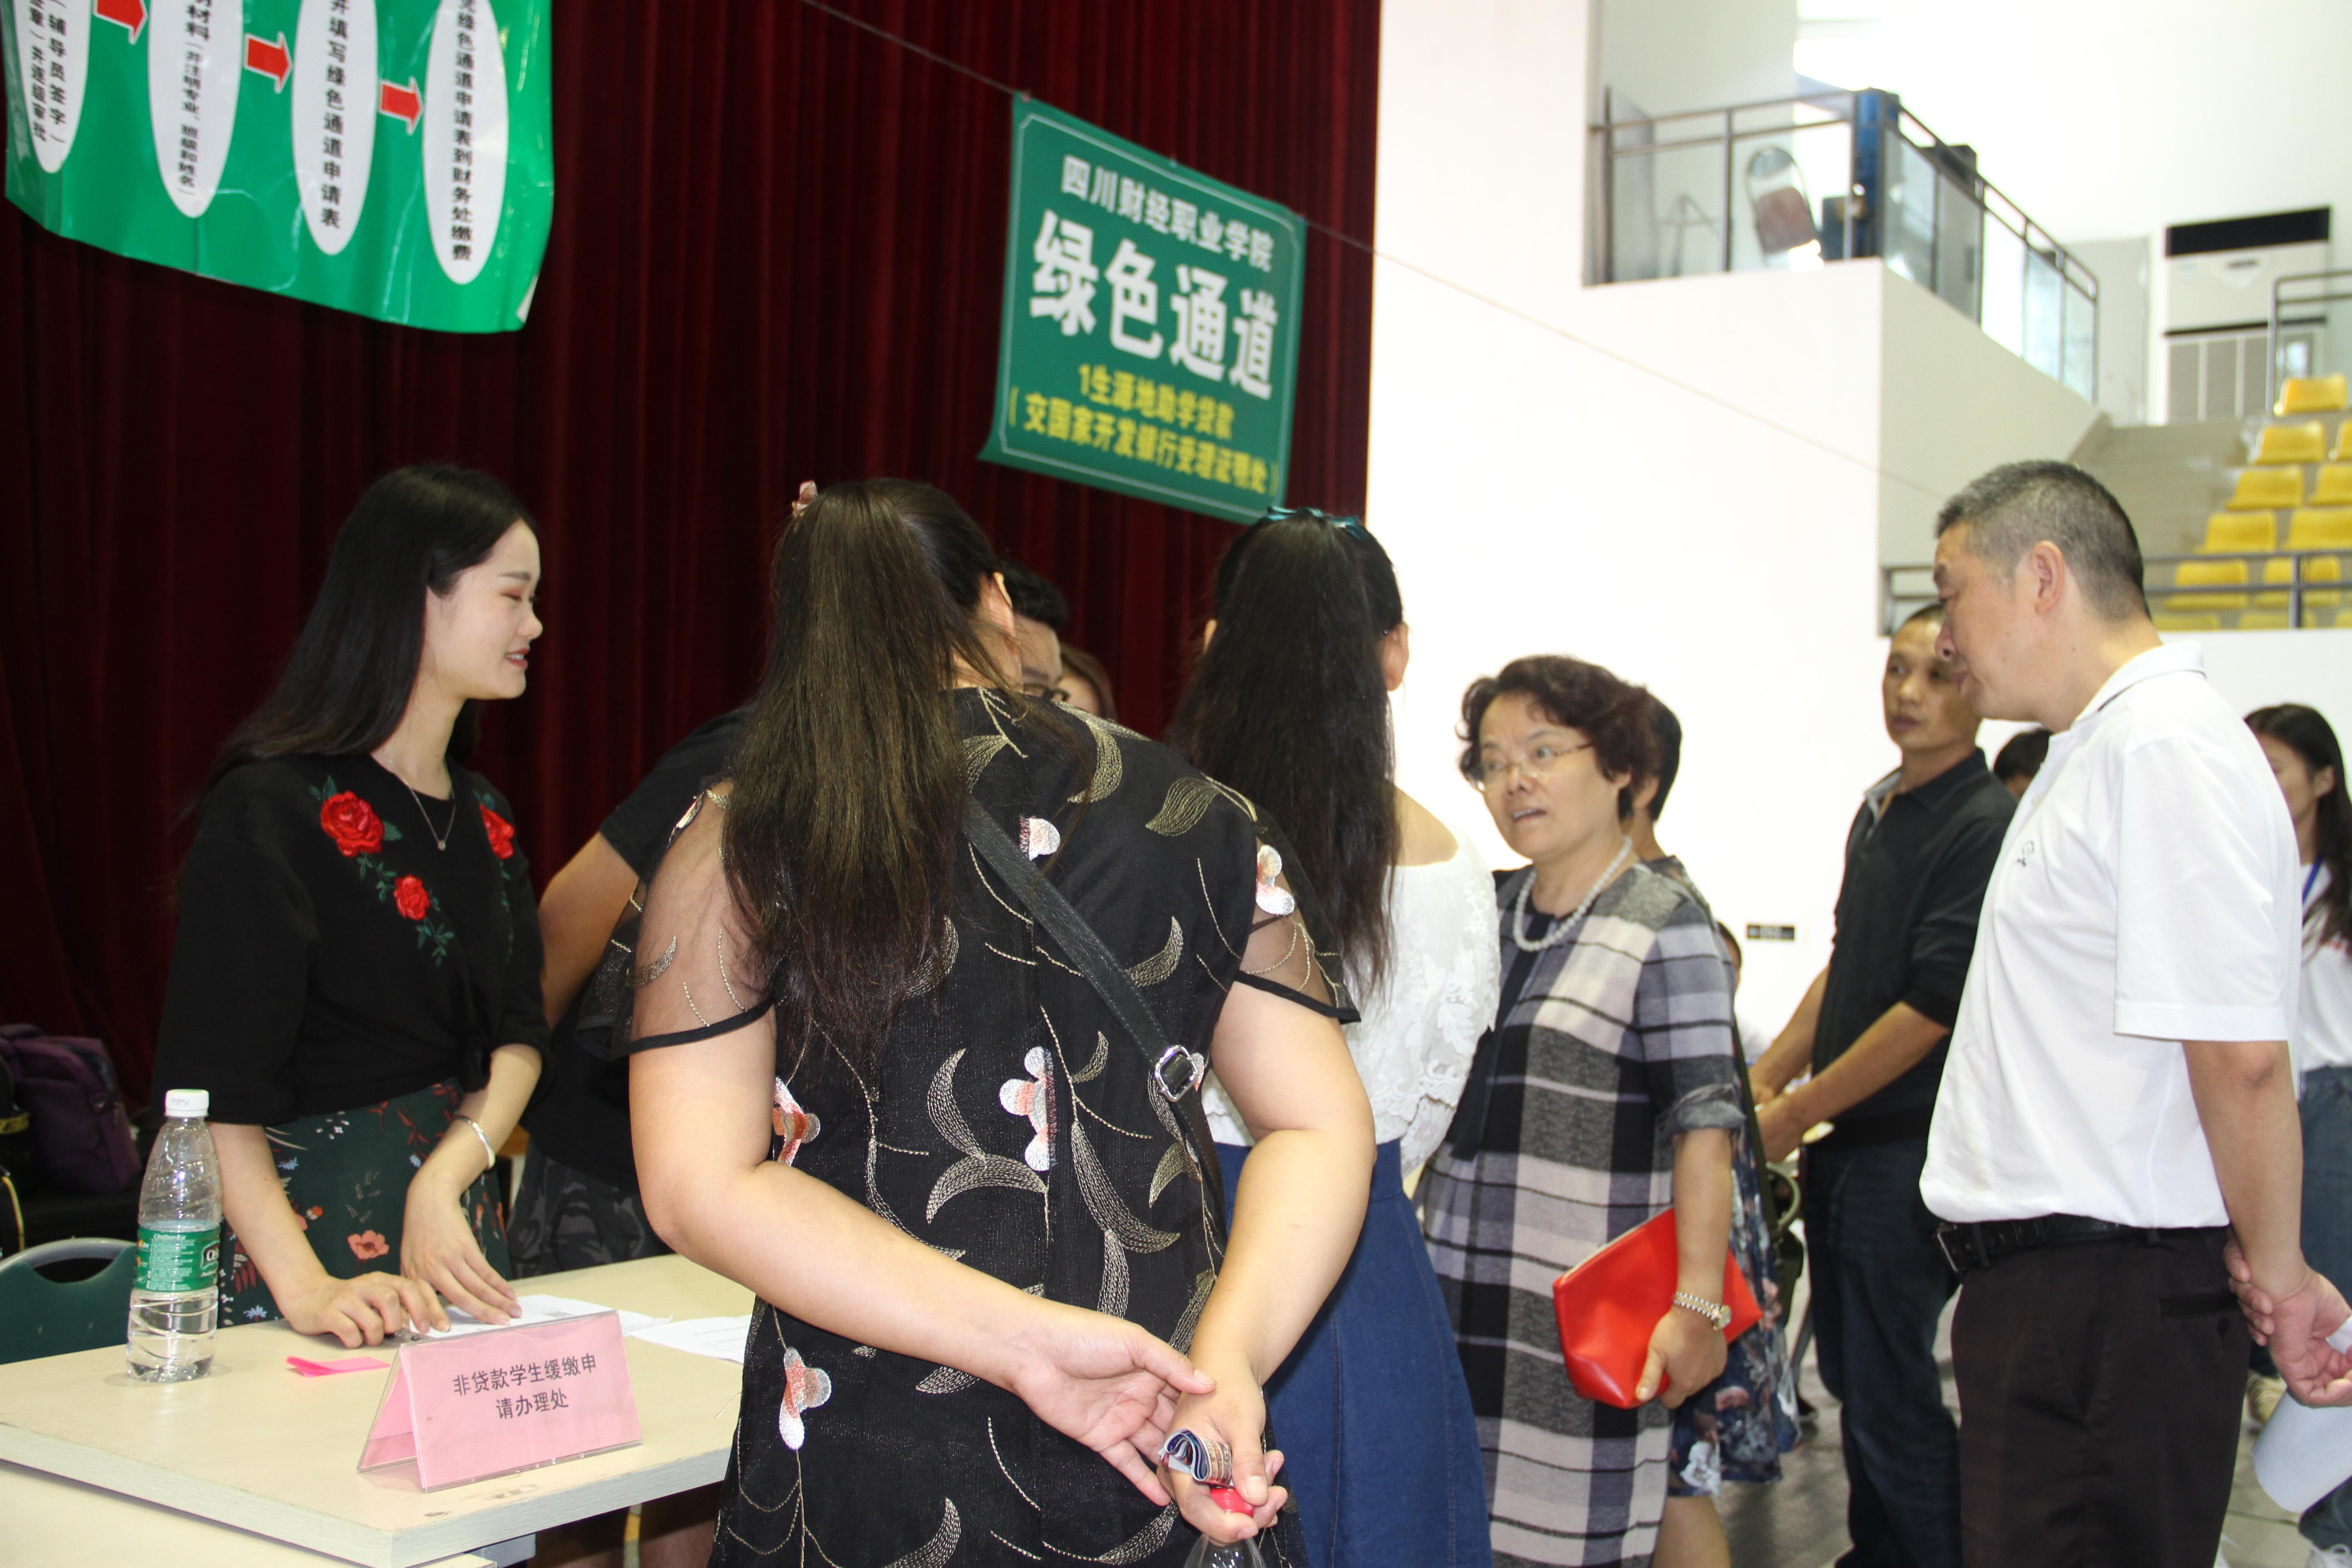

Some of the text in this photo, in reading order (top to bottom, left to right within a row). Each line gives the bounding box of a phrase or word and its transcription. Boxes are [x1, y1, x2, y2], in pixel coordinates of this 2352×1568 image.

[1061, 154, 1275, 272] 四川财经职业学院
[1029, 208, 1279, 401] 绿色通道
[453, 1352, 597, 1396] 非贷款学生缓缴申
[496, 1388, 569, 1420] 请办理处
